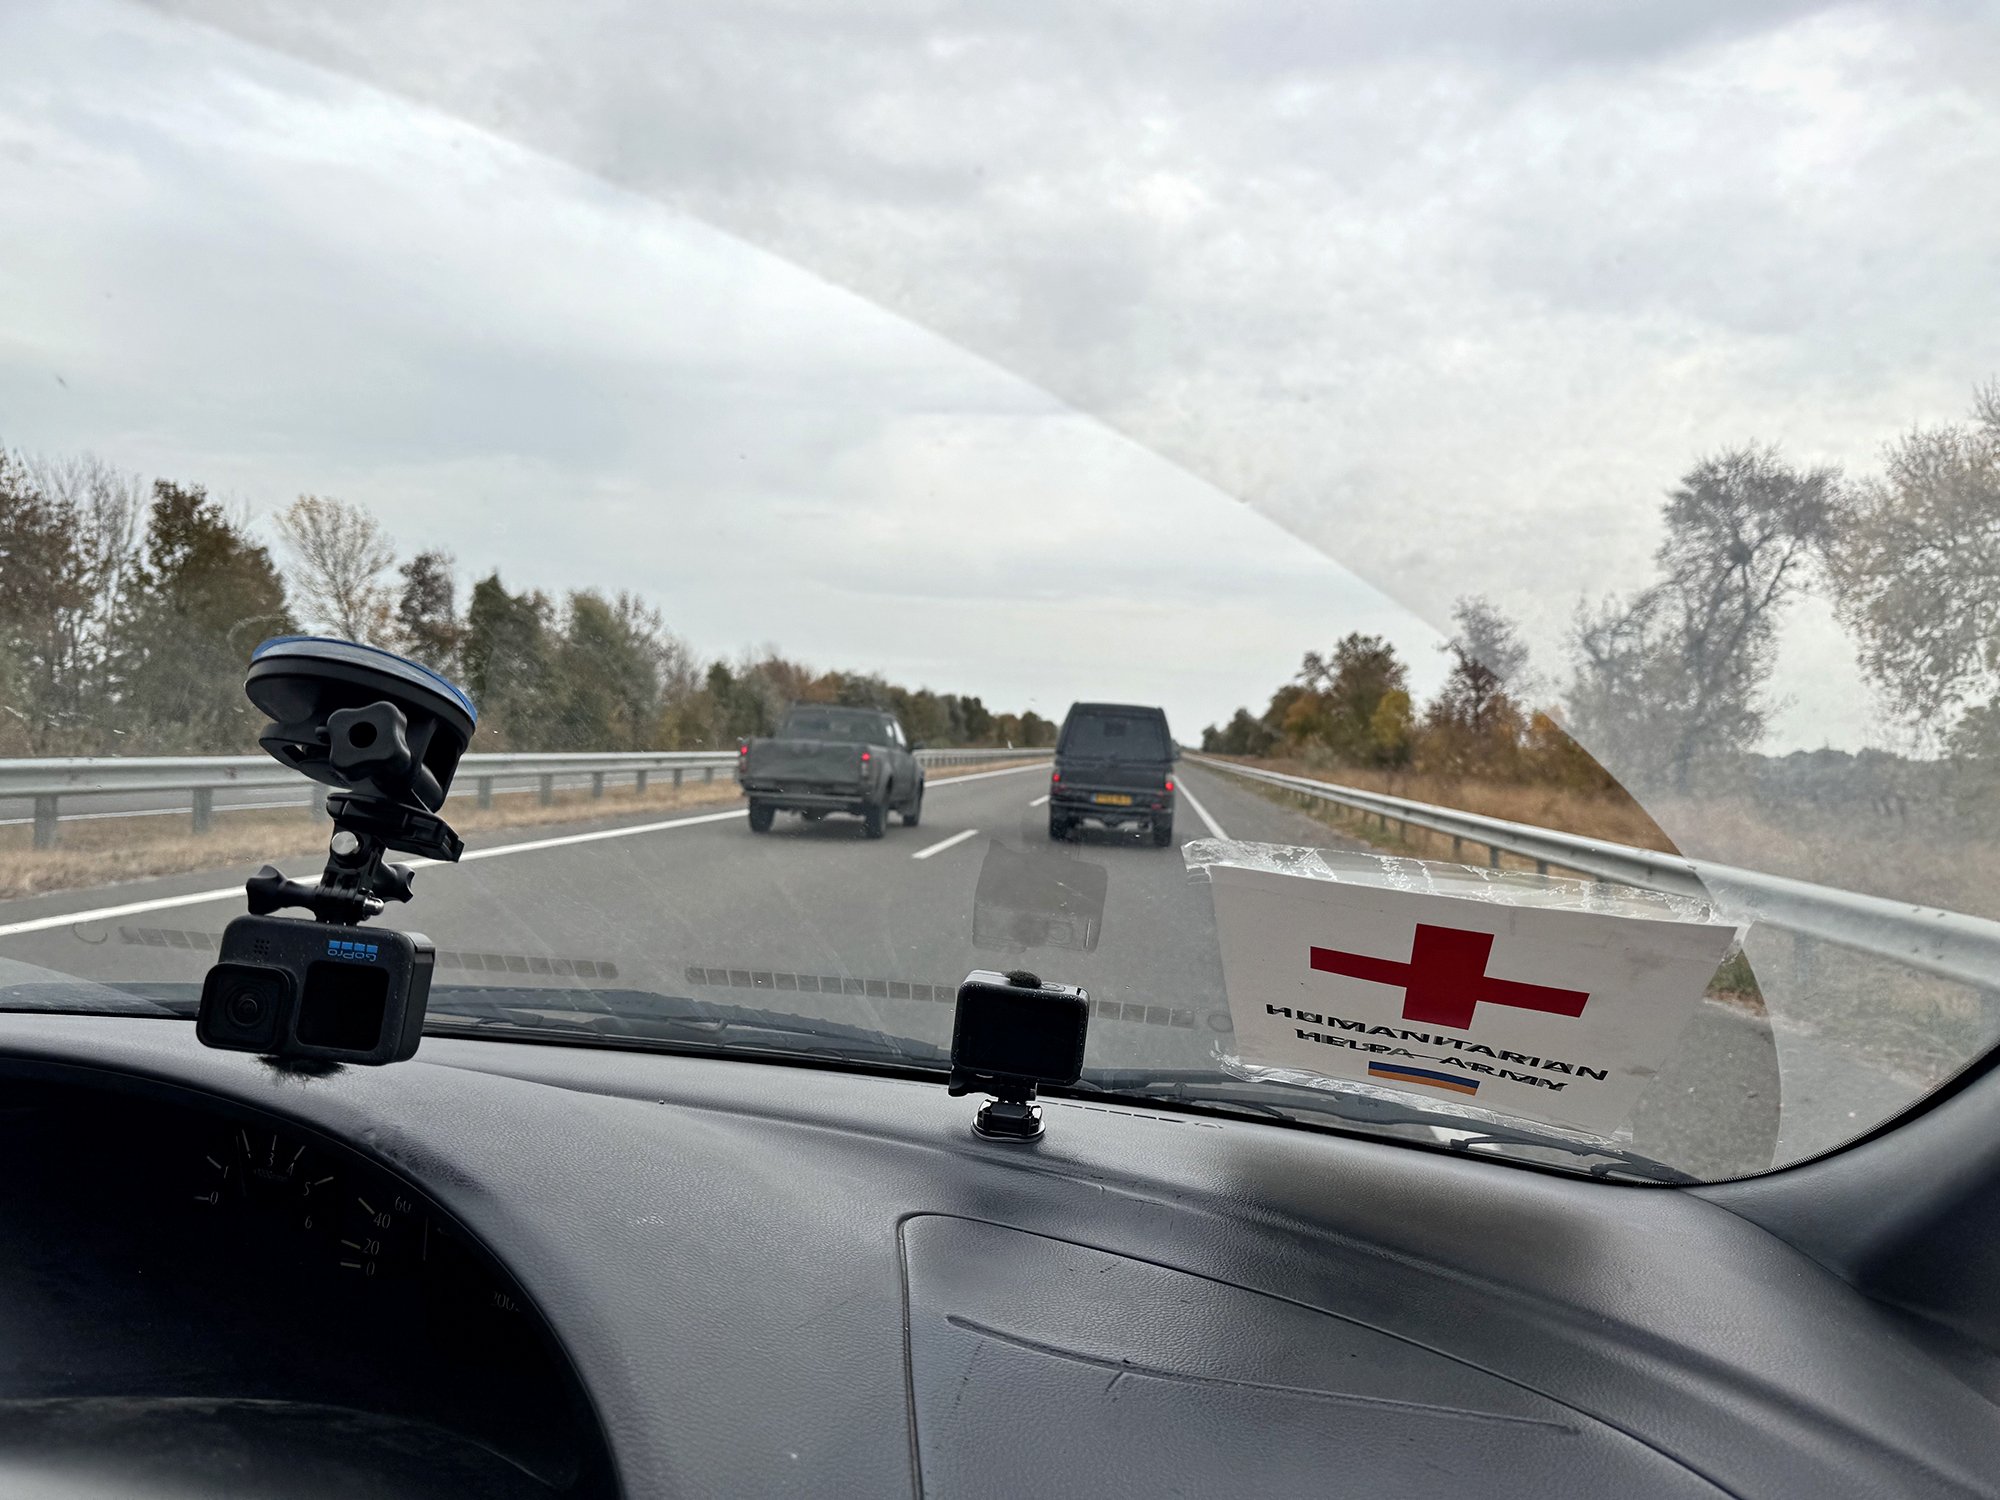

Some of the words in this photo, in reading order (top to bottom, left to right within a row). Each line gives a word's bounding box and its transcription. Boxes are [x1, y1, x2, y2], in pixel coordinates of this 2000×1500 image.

[328, 949, 377, 962] GoPro
[1266, 1004, 1608, 1081] HUMANITARIAN
[304, 1215, 313, 1230] 6
[373, 1212, 391, 1229] 40
[362, 1238, 380, 1256] 20
